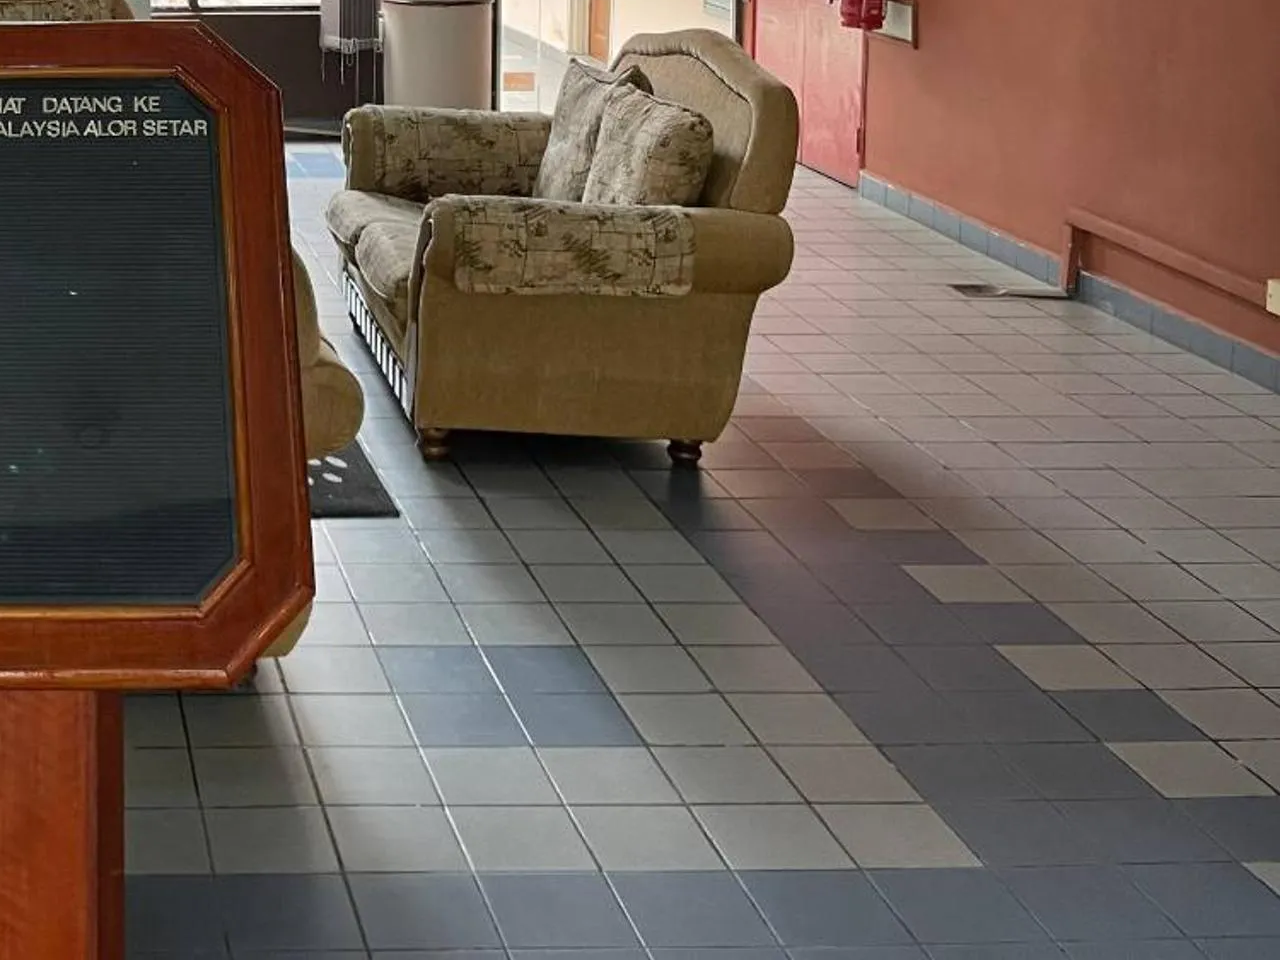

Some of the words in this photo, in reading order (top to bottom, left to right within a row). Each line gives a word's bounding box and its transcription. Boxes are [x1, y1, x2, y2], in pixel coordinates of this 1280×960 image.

[42, 96, 122, 113] DATANG
[134, 95, 161, 112] KE
[82, 120, 137, 137] ALOR
[142, 120, 208, 137] SETAR
